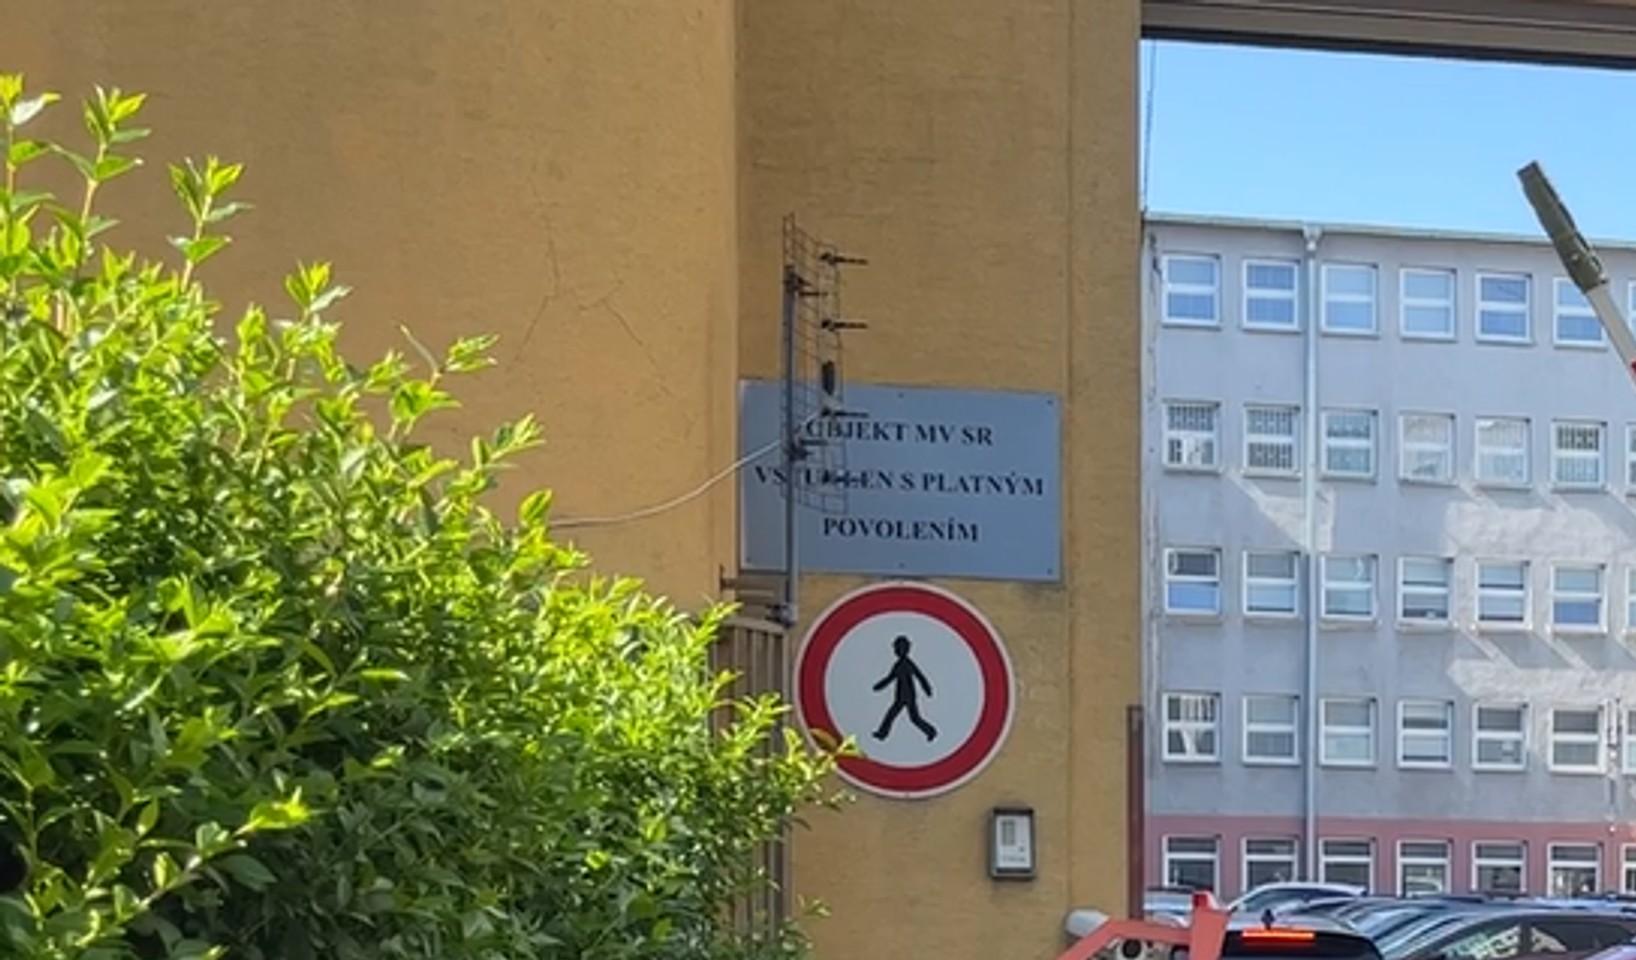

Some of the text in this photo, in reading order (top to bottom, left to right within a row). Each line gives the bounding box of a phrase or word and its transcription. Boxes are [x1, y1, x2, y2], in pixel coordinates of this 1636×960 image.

[806, 419, 993, 446] OBJEKT MV SR
[900, 472, 915, 491] S
[922, 469, 1044, 496] PLATNÝM
[823, 516, 979, 542] POVOLENÍM
